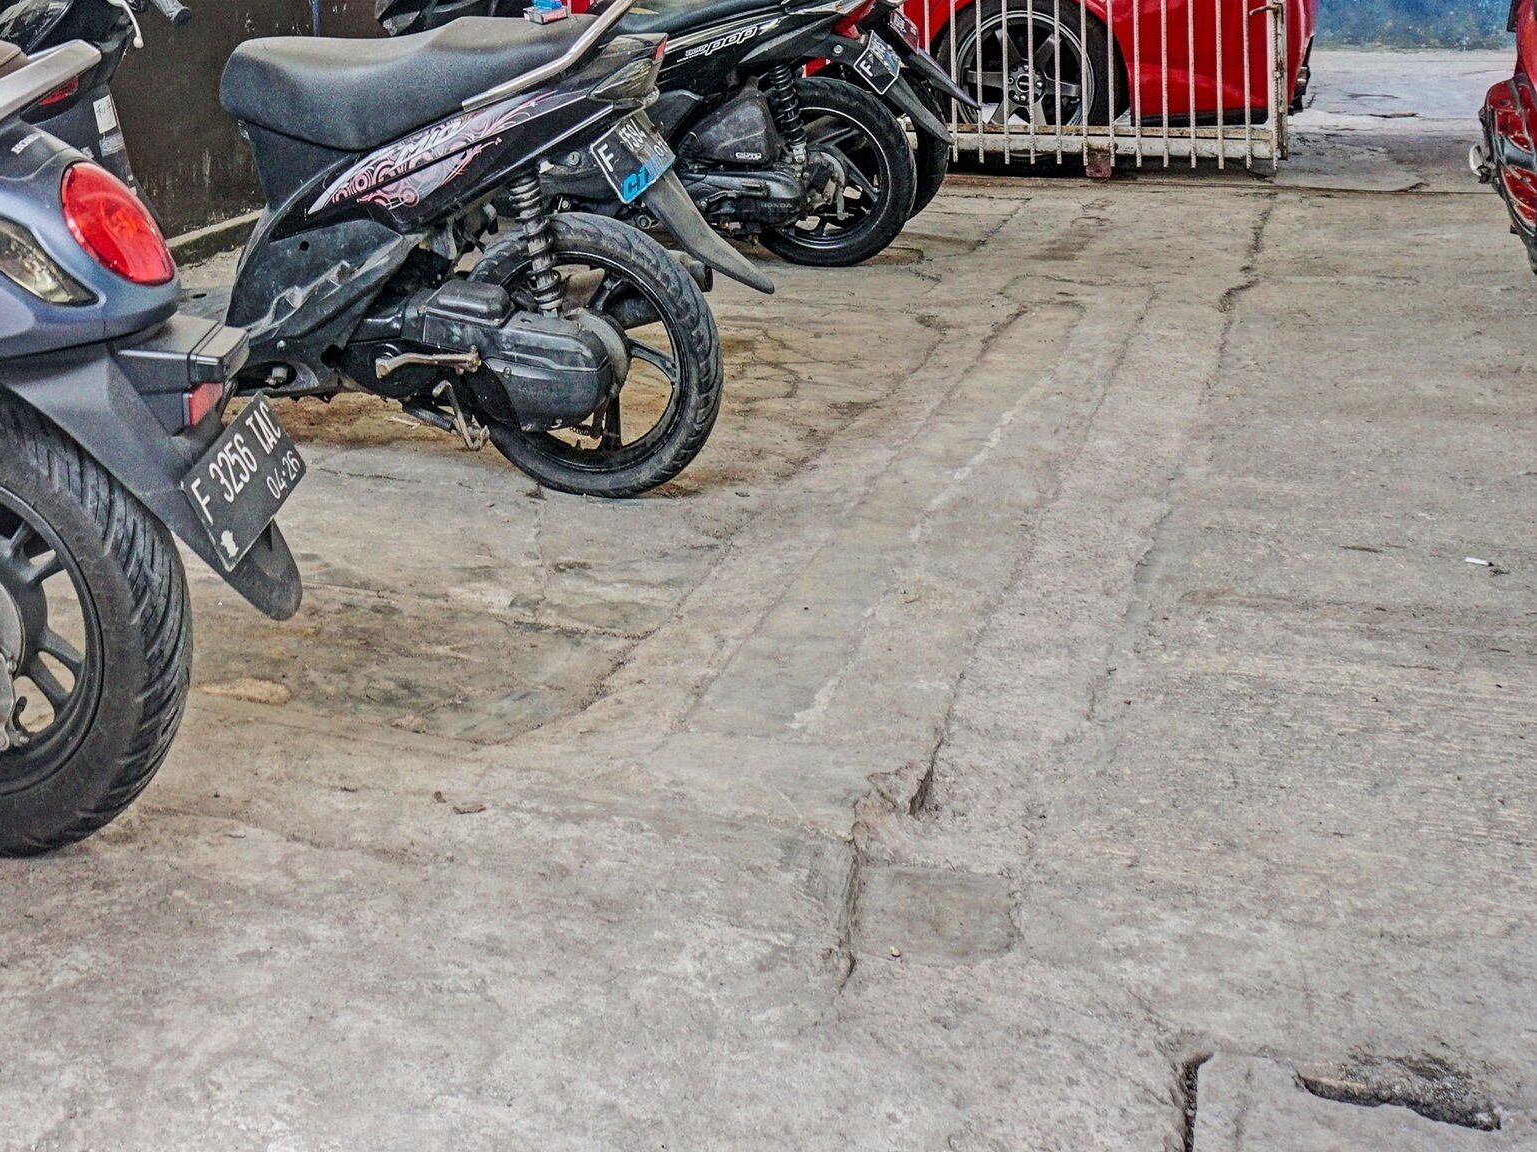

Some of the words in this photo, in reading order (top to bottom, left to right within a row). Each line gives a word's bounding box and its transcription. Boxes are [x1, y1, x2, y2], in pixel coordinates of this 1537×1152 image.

[859, 59, 874, 78] F
[597, 143, 614, 173] F
[190, 477, 214, 526] F
[209, 432, 258, 503] 3256
